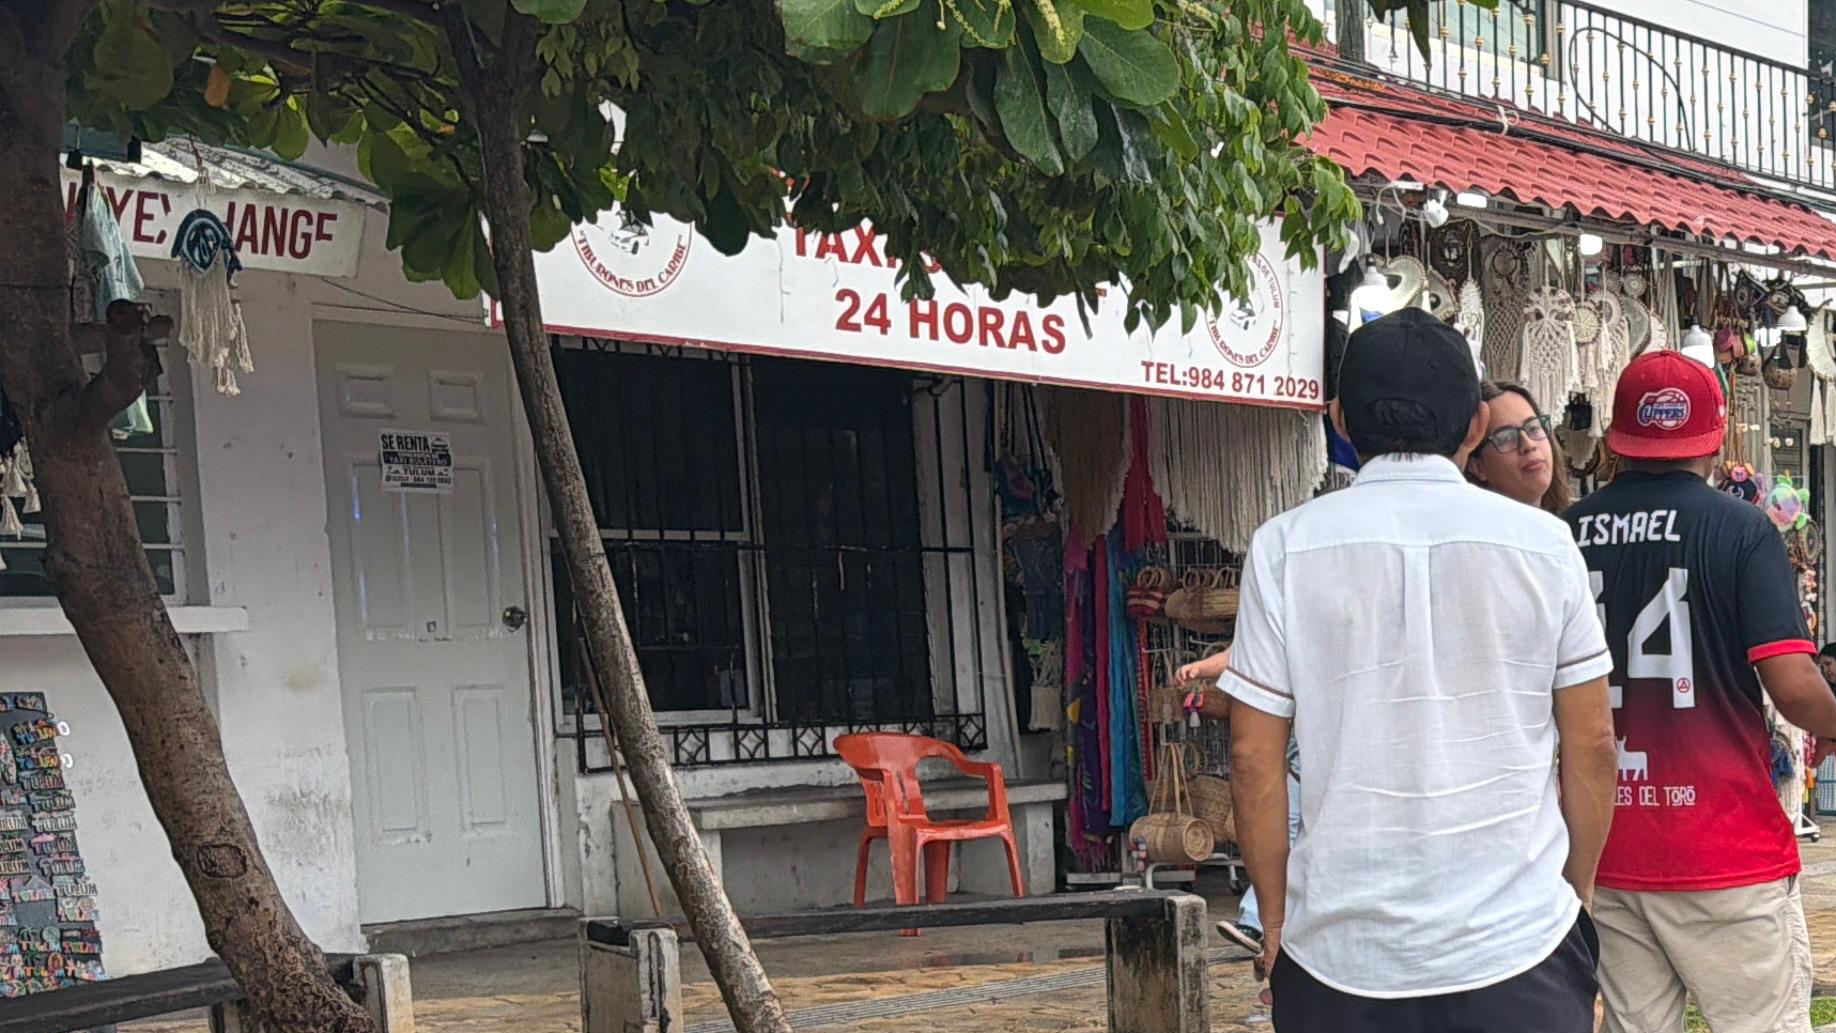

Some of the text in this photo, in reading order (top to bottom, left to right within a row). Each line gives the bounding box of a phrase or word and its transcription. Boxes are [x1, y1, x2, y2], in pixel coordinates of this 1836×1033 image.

[636, 278, 659, 293] DEL
[835, 288, 1067, 355] 24 HORAS
[1141, 360, 1320, 400] TEL:984 871 2029
[381, 434, 430, 451] SE RENTA
[1577, 510, 1681, 548] ISMAEL
[1639, 786, 1660, 806] DEL
